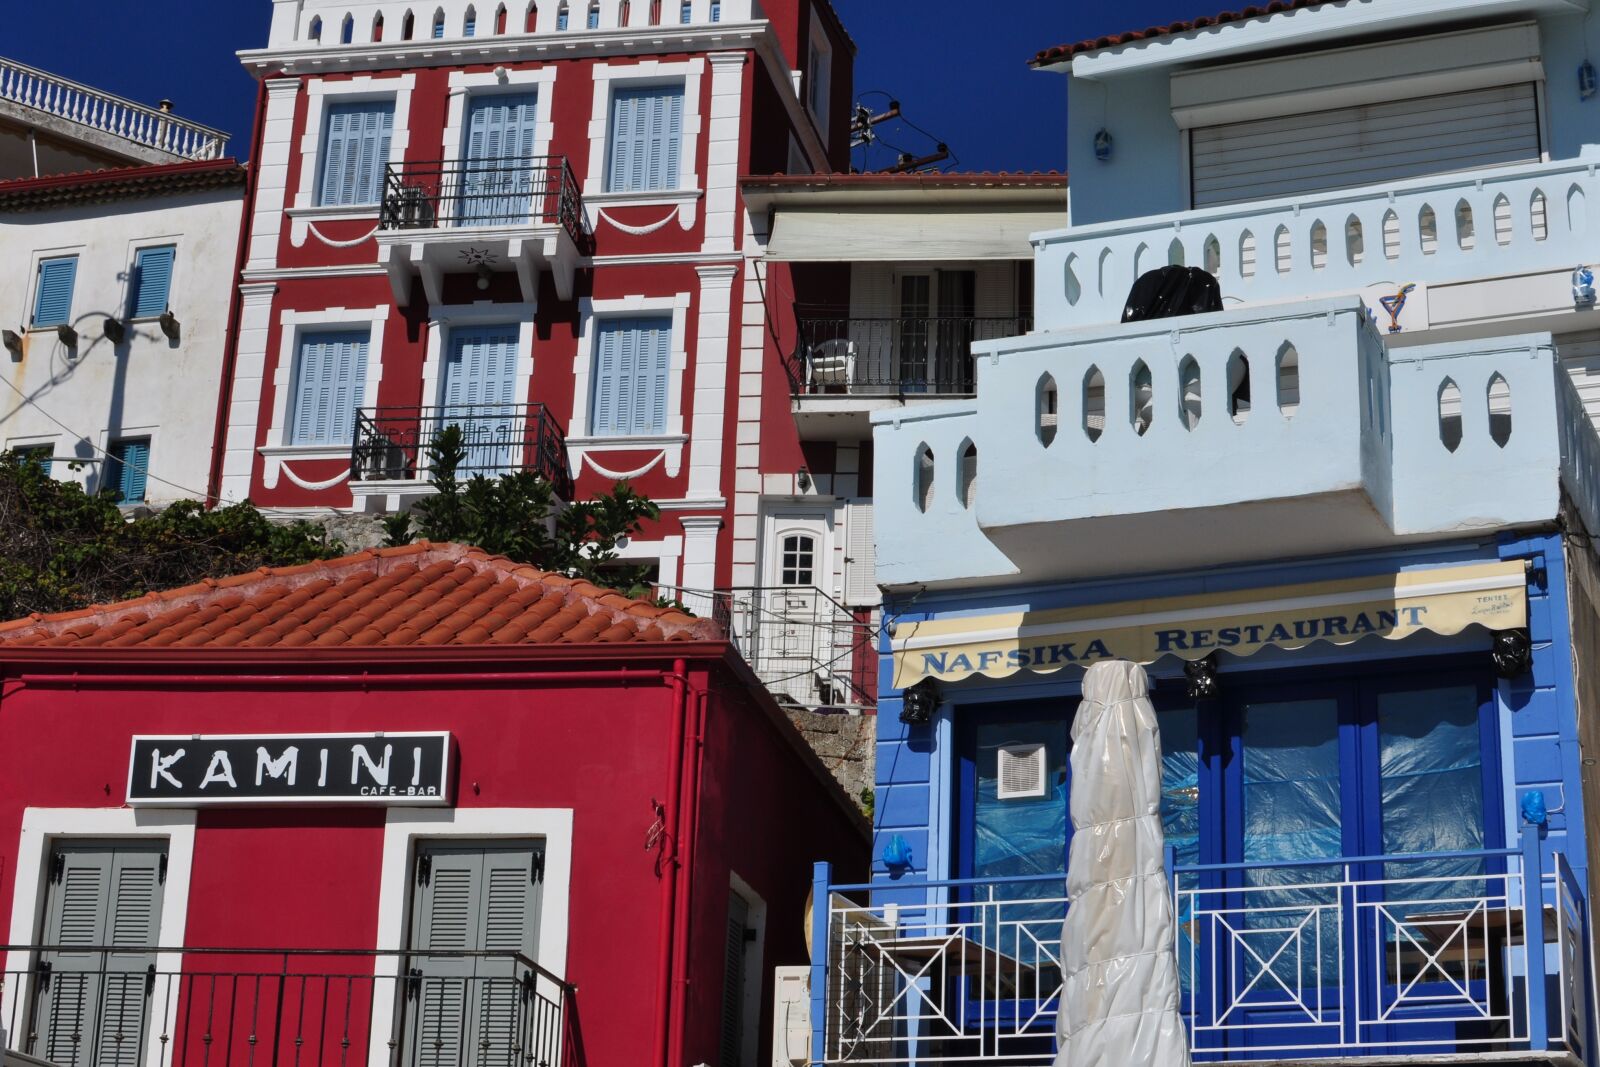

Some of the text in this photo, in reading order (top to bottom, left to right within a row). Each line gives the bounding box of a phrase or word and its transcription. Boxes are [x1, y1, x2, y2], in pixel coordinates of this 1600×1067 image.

[921, 606, 1428, 675] NAFSIKA RESTAURANT
[150, 743, 422, 790] KAMINI
[360, 786, 436, 796] CAFE-BAR
